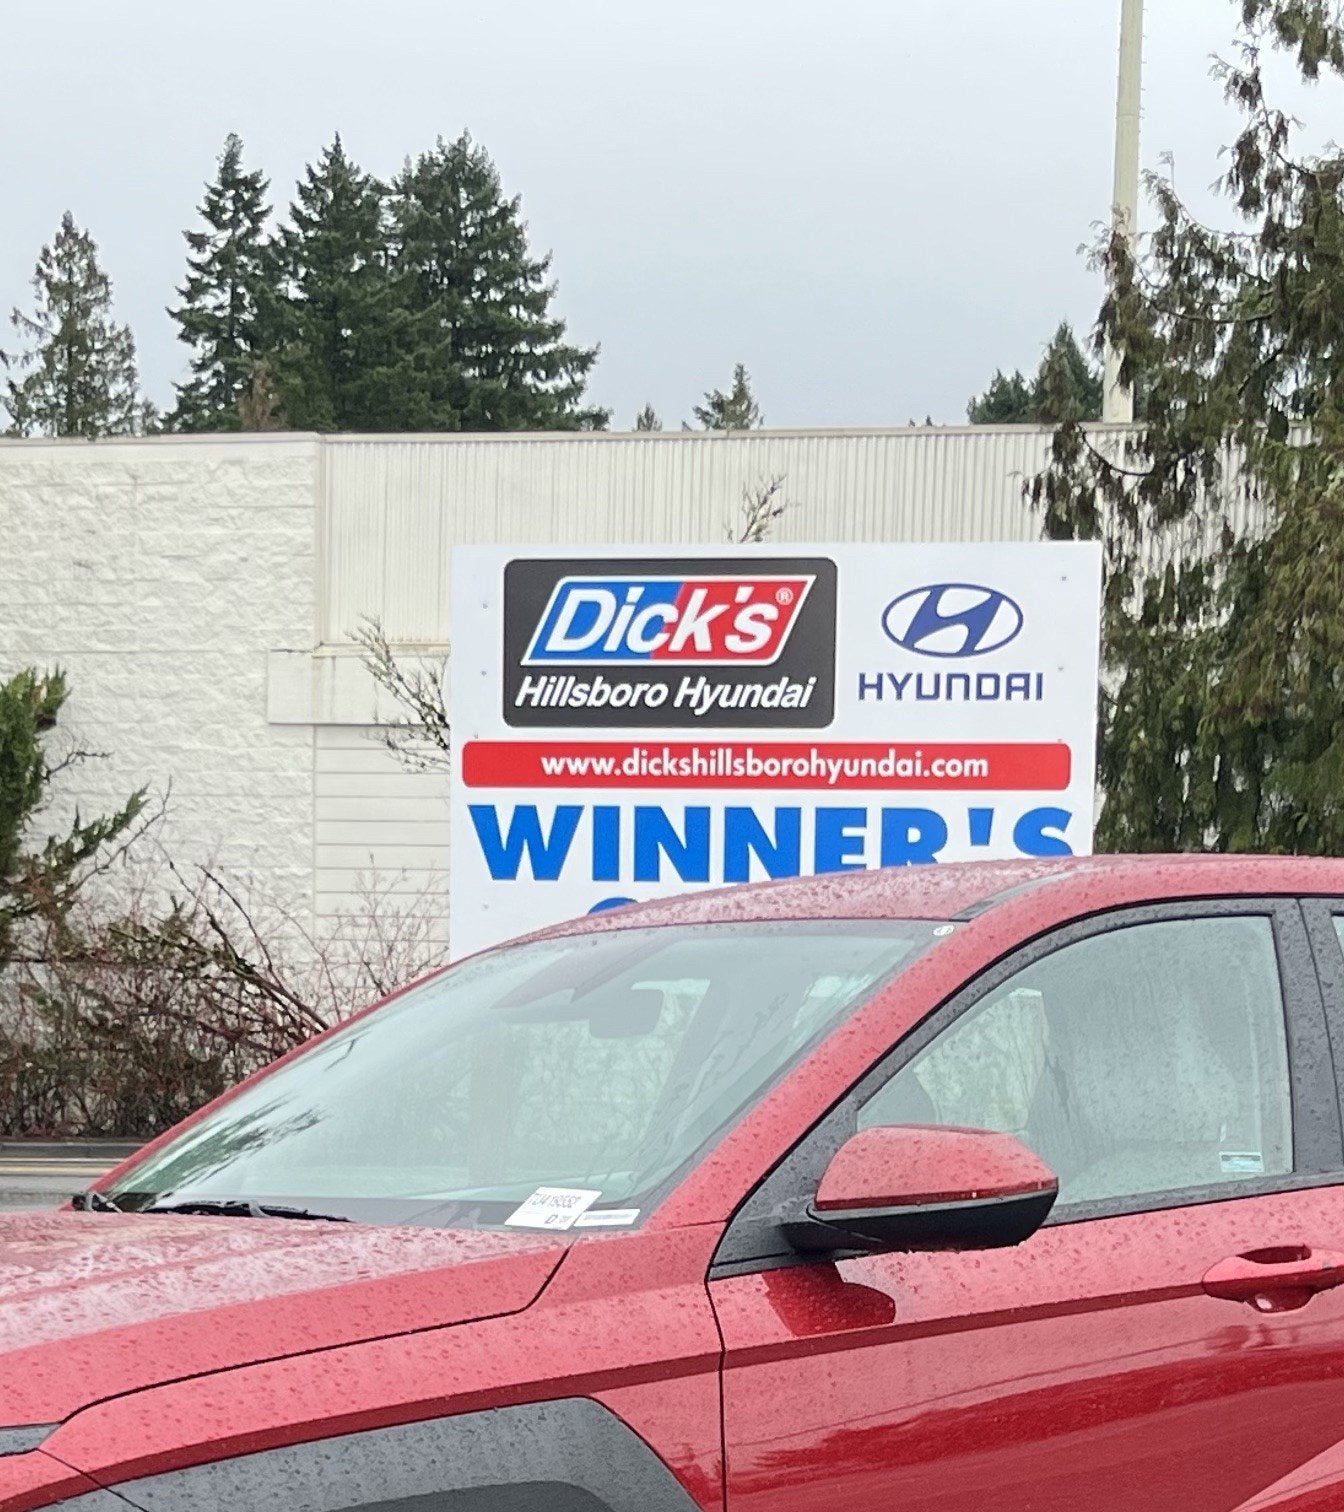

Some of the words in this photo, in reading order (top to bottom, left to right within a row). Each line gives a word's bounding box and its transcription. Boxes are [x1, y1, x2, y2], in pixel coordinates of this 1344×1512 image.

[545, 583, 780, 654] Dick's
[514, 675, 667, 710] Hillsboro
[674, 676, 818, 717] Hyundai
[858, 671, 1044, 701] HYUNDAI
[540, 748, 990, 787] www.dickshillsborohyundai.com
[467, 803, 1075, 884] WINNER'S
